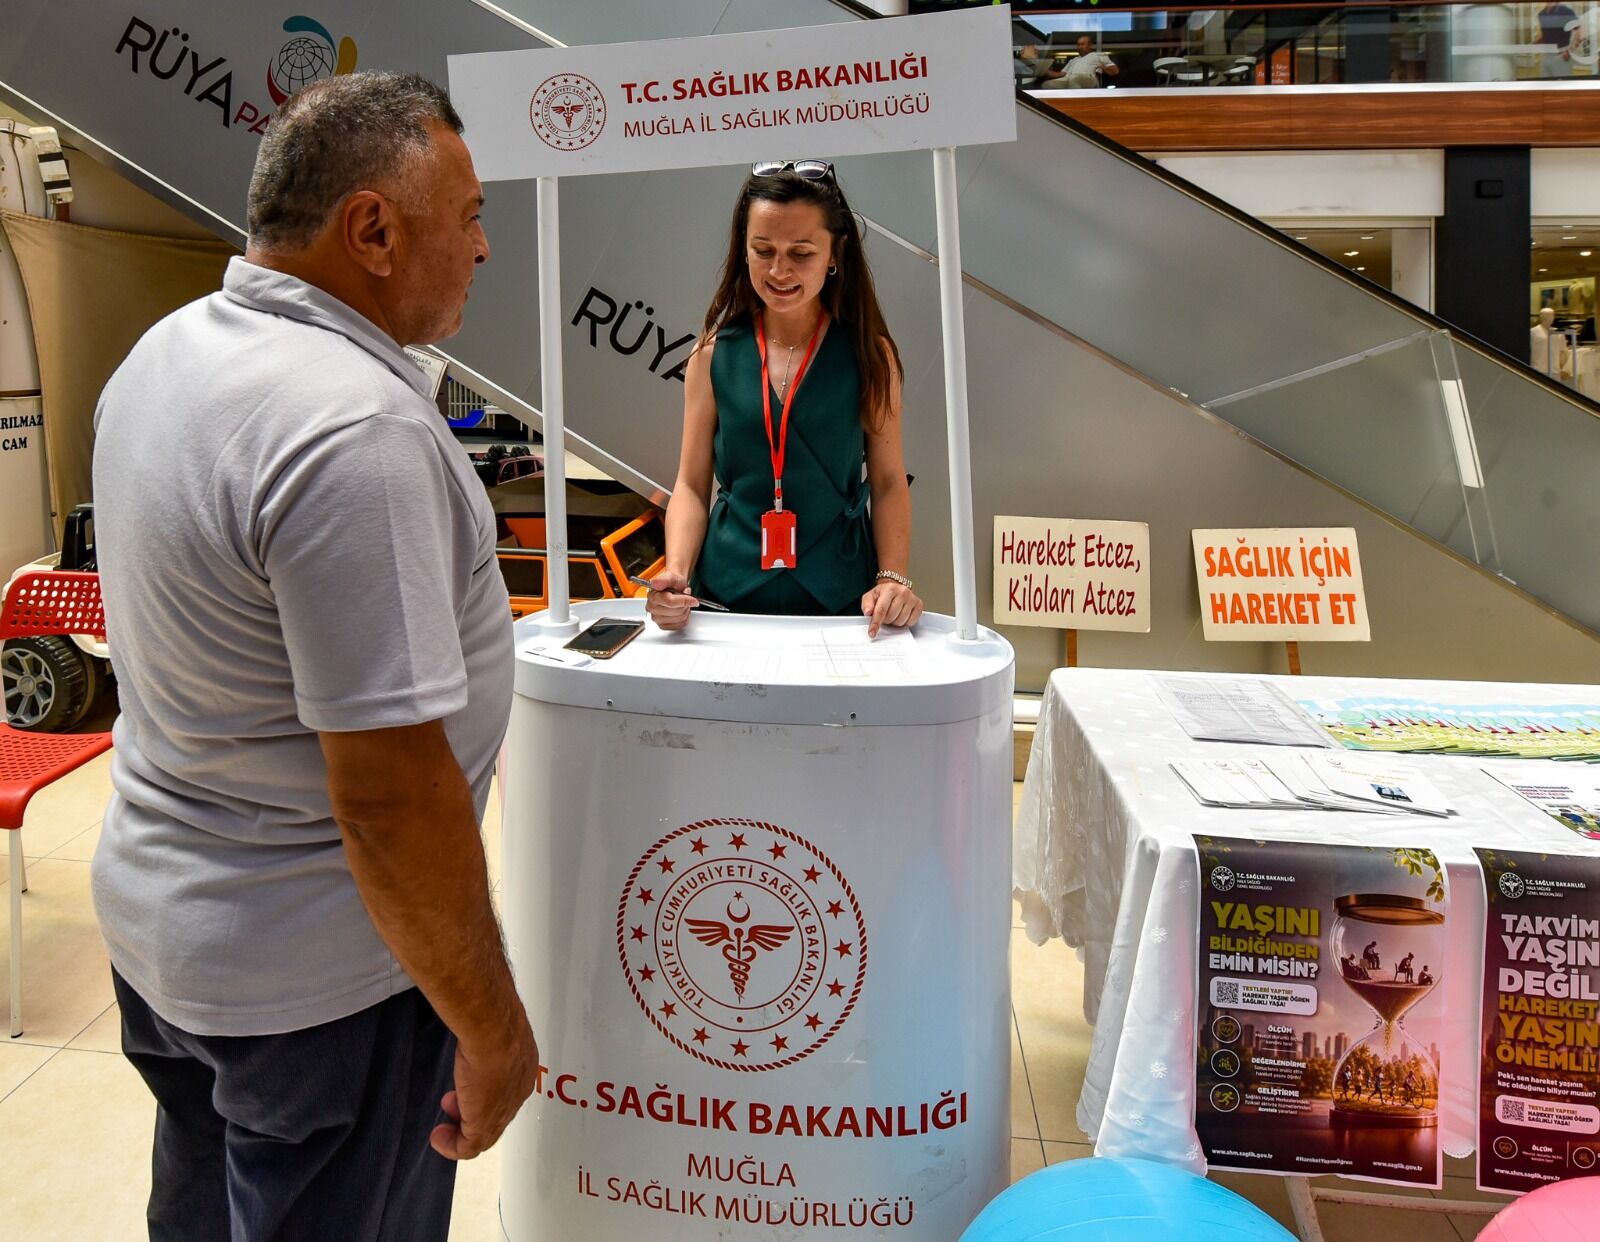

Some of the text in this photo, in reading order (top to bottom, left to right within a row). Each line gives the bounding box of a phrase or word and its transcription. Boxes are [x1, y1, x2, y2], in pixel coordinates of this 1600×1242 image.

[621, 53, 929, 104] T.C. SAĞLIK BAKANLIĞI
[233, 101, 272, 135] PA
[624, 94, 930, 138] MUĞLA İL SAĞLIK MÜDÜRLÜĞÜ
[0, 415, 43, 429] RILMAZ
[2, 437, 27, 450] CAM
[1001, 529, 1140, 574] Hareket Etcez,
[1204, 537, 1352, 587] SAĞLIK İÇİN
[1008, 574, 1137, 616] Kiloları Atcez
[1210, 593, 1356, 625] HAREKET ET
[1210, 901, 1319, 937] YAŞINI
[1501, 914, 1599, 938] TAKVİM
[661, 864, 820, 1015] TÜRKİYE CUMHURİYETİ SAĞLIK BAKANLIĞI
[1210, 934, 1318, 960] BİLDİĞİNDEN
[1501, 935, 1600, 969] YAŞIN
[1209, 952, 1318, 978] EMİN MİSİN?
[1242, 985, 1269, 993] TESTLERİ
[1242, 992, 1269, 1000] HAREKET
[1498, 968, 1599, 1000] DEĞİL
[1242, 998, 1268, 1006] SAĞLIKLI
[1500, 994, 1598, 1020] HAREKET
[1268, 1024, 1293, 1034] ÖLÇÜM
[1499, 1012, 1599, 1049] YAŞIN
[1251, 1057, 1306, 1069] DEĞERLENDİRME
[1496, 1040, 1597, 1073] ÖNEMLİ!
[1257, 1087, 1299, 1097] GELİŞTİRME
[1497, 1071, 1515, 1080] Peki,
[1530, 1076, 1557, 1086] hareket
[1558, 1080, 1583, 1088] yaşının
[1497, 1080, 1597, 1098] kaç olduğunu biliyor musun?
[536, 1065, 968, 1137] T.C. SAĞLIK BAKANLIĞI
[1527, 1111, 1554, 1119] HAREKET
[687, 1153, 796, 1188] MUĞLA
[577, 1165, 913, 1227] İL SAĞLIK MÜDÜRLÜĞÜ
